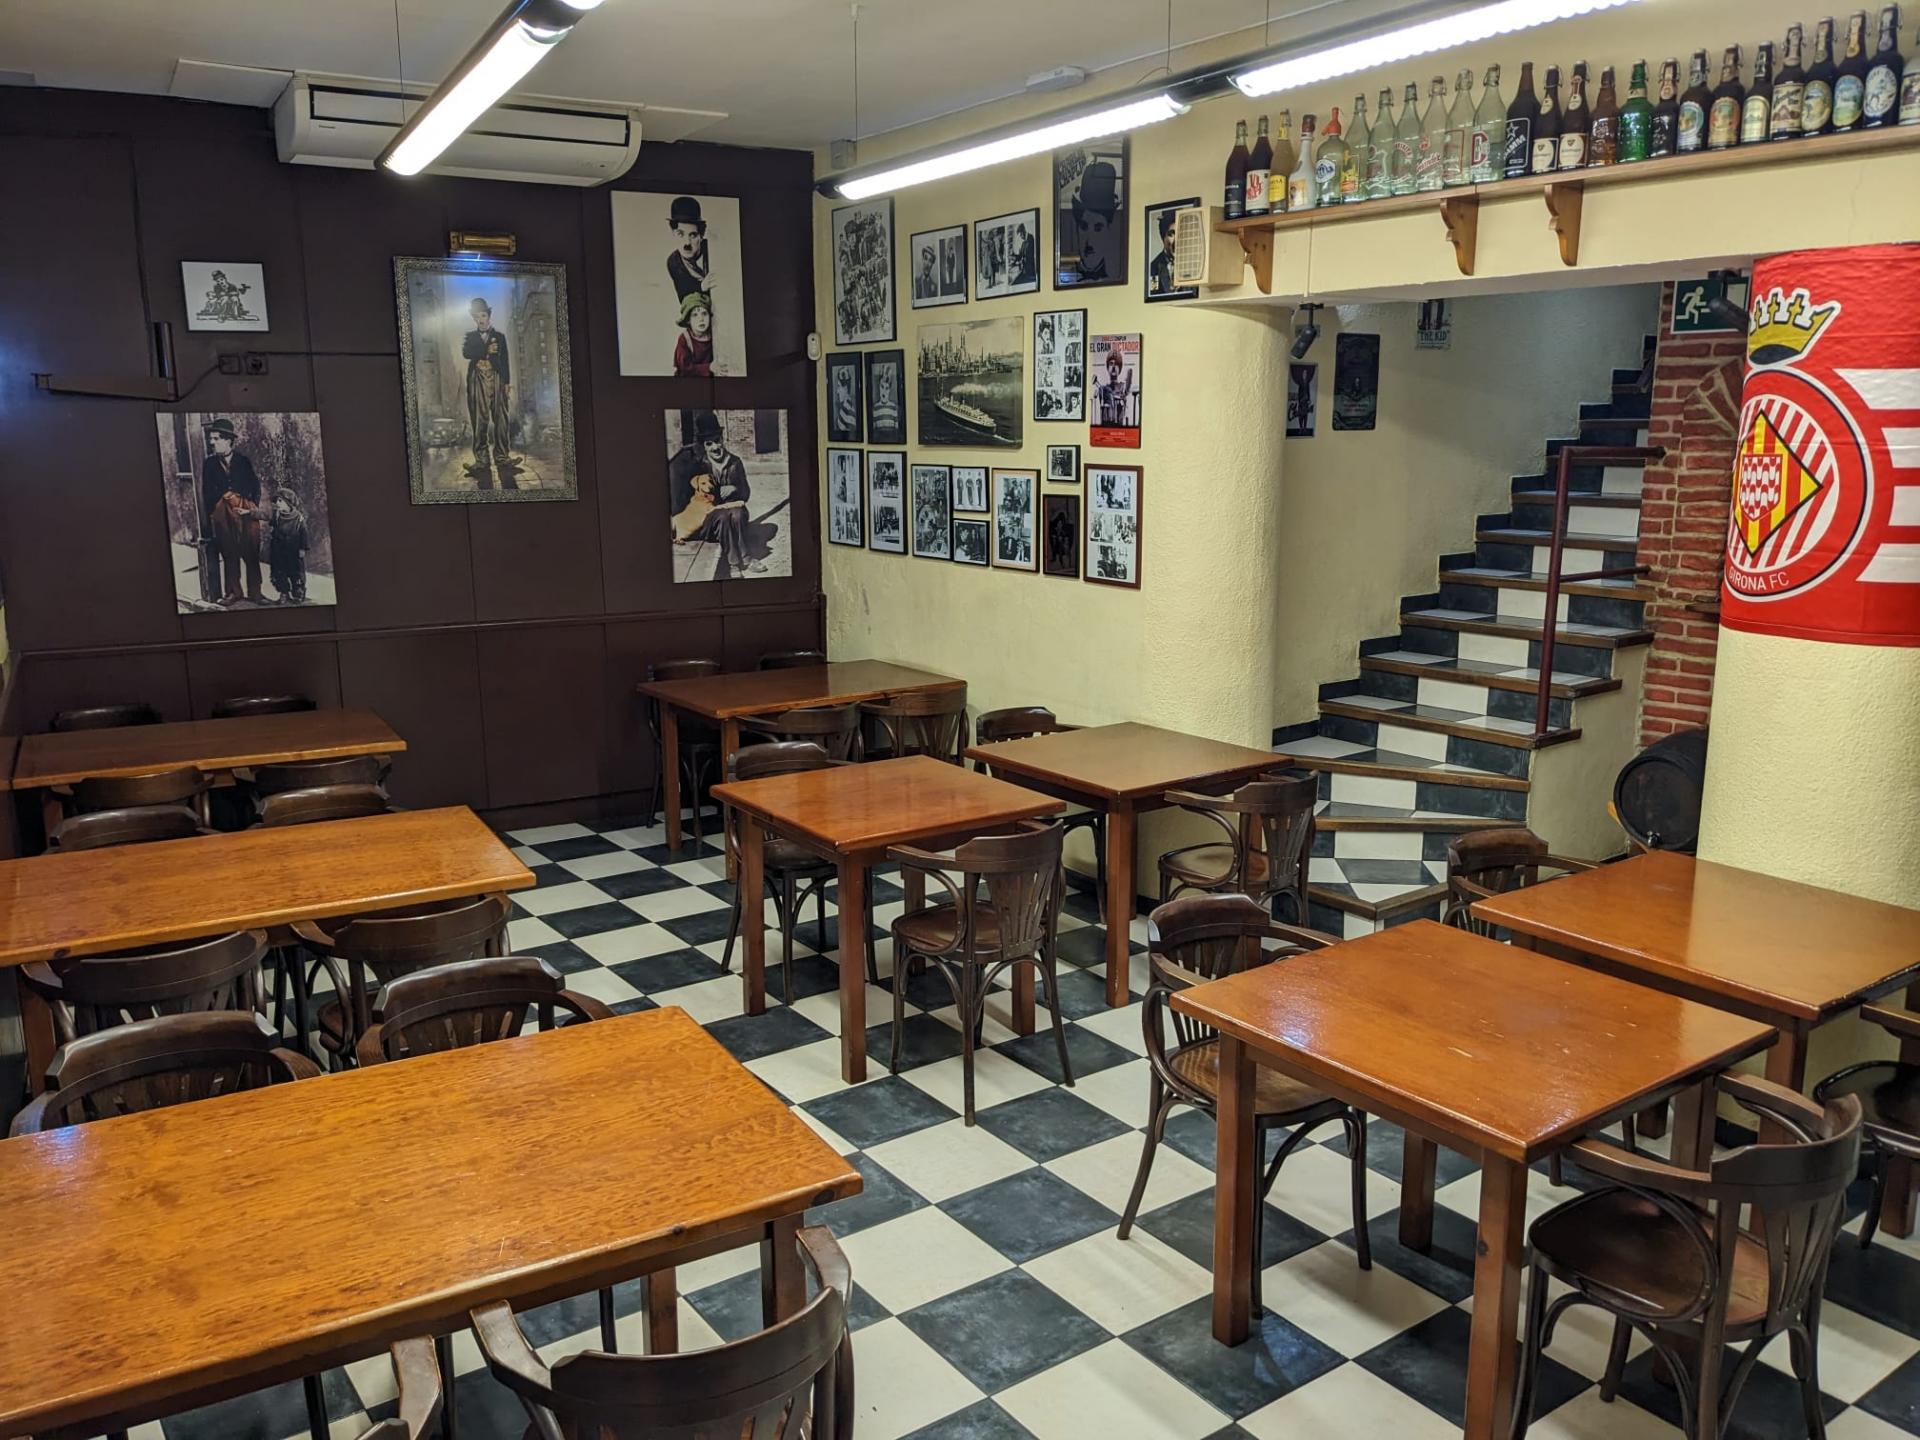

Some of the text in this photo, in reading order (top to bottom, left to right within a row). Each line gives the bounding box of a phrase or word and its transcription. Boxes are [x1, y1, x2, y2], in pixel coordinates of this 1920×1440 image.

[1090, 342, 1096, 353] EL
[1097, 342, 1111, 353] GRAN
[1729, 566, 1790, 591] GIRONA FC
